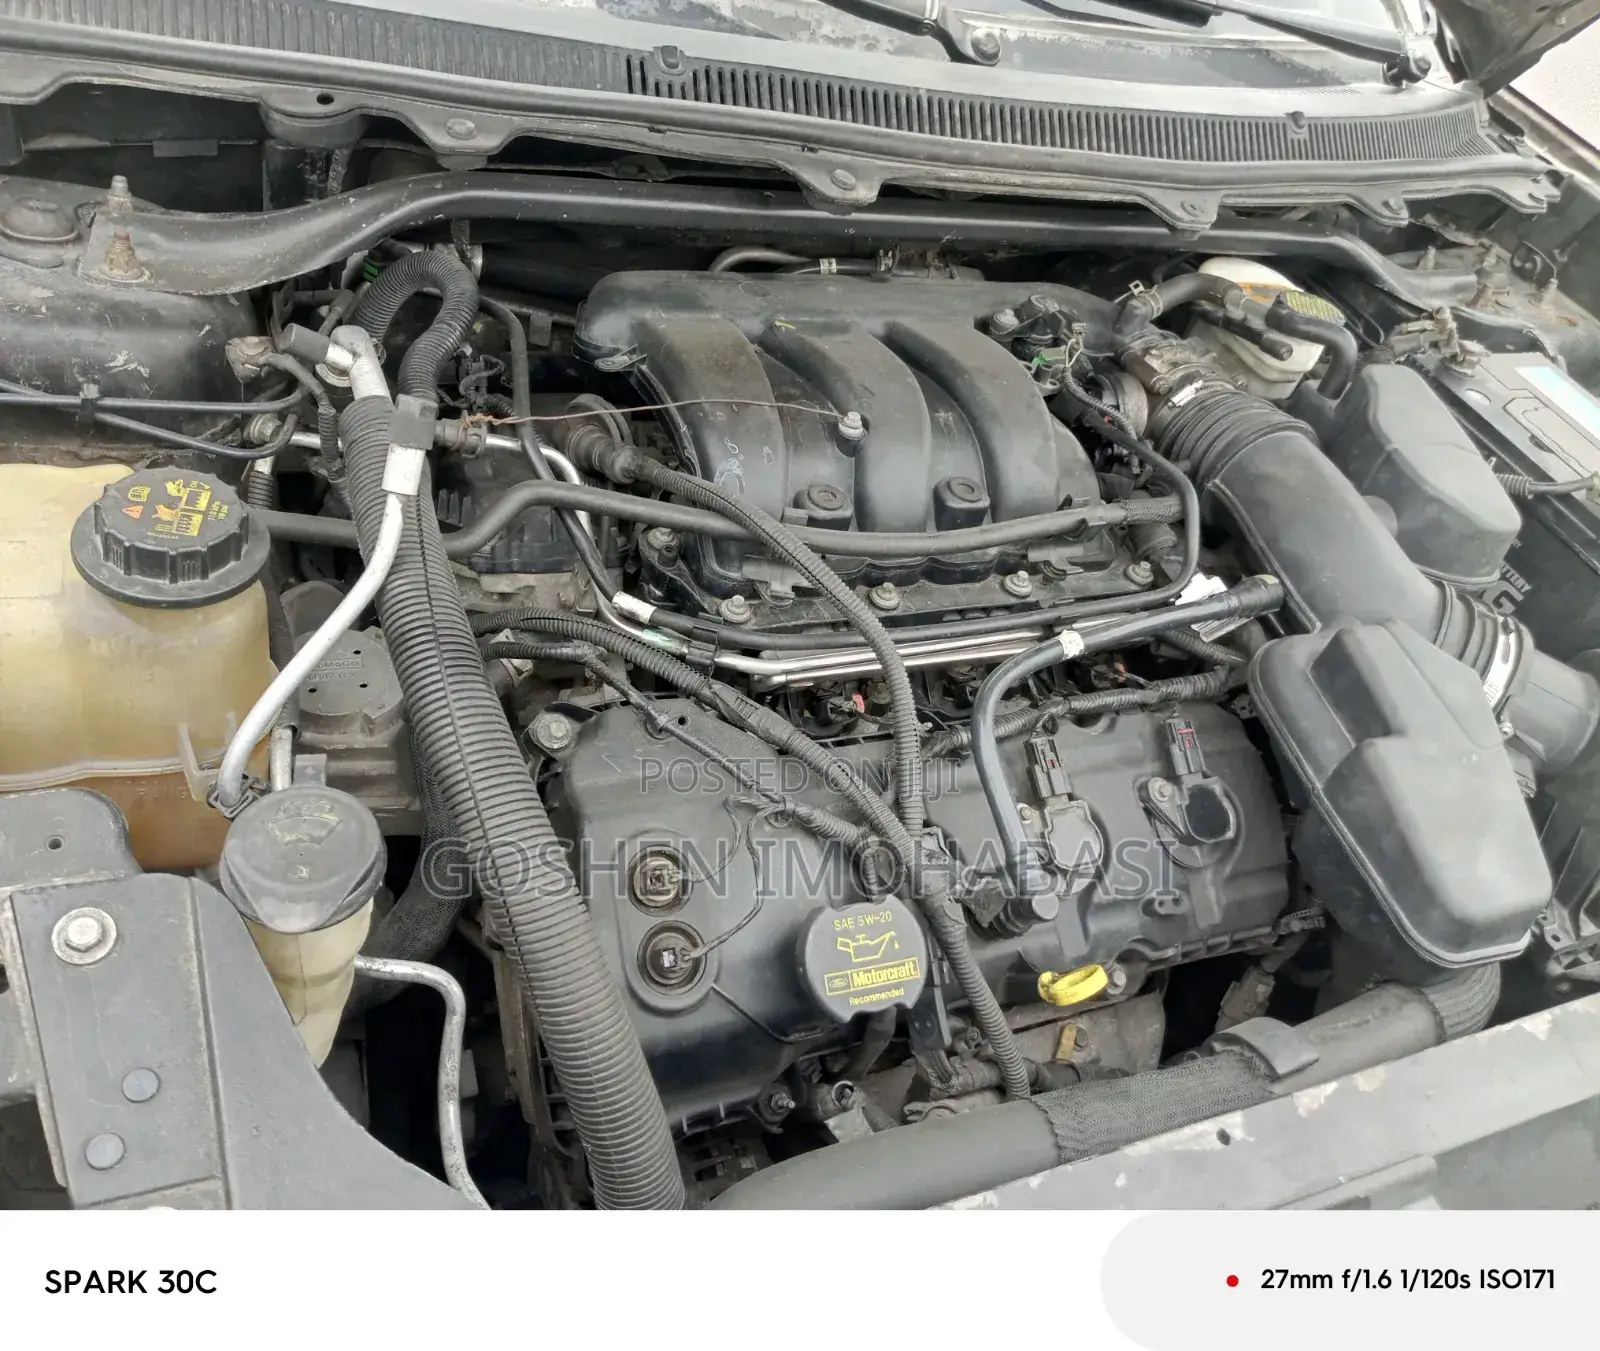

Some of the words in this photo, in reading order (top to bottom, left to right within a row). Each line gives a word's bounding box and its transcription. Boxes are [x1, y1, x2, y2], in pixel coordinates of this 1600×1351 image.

[1499, 563, 1532, 593] TTERY
[833, 917, 855, 931] SAE
[857, 910, 893, 928] 5W-20
[851, 960, 917, 988] Motorcraft
[848, 987, 905, 1006] Recommended
